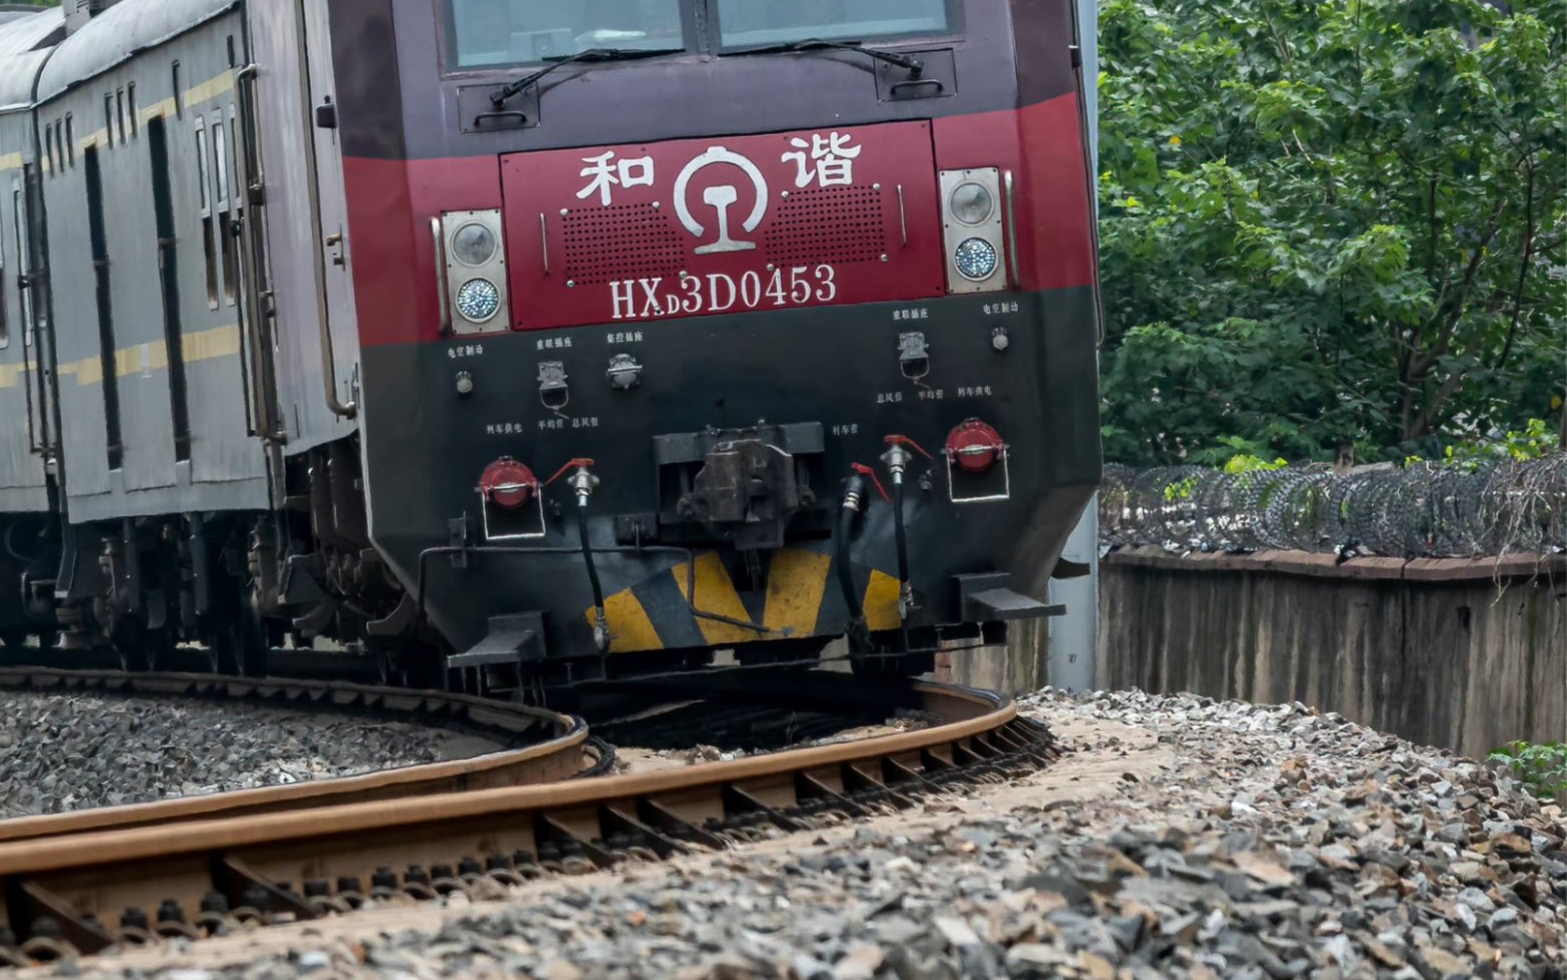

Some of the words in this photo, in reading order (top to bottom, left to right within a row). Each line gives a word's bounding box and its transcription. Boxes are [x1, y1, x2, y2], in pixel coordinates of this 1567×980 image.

[576, 150, 655, 207] 和
[781, 131, 862, 188] 谐
[608, 263, 837, 319] HXD3D0453
